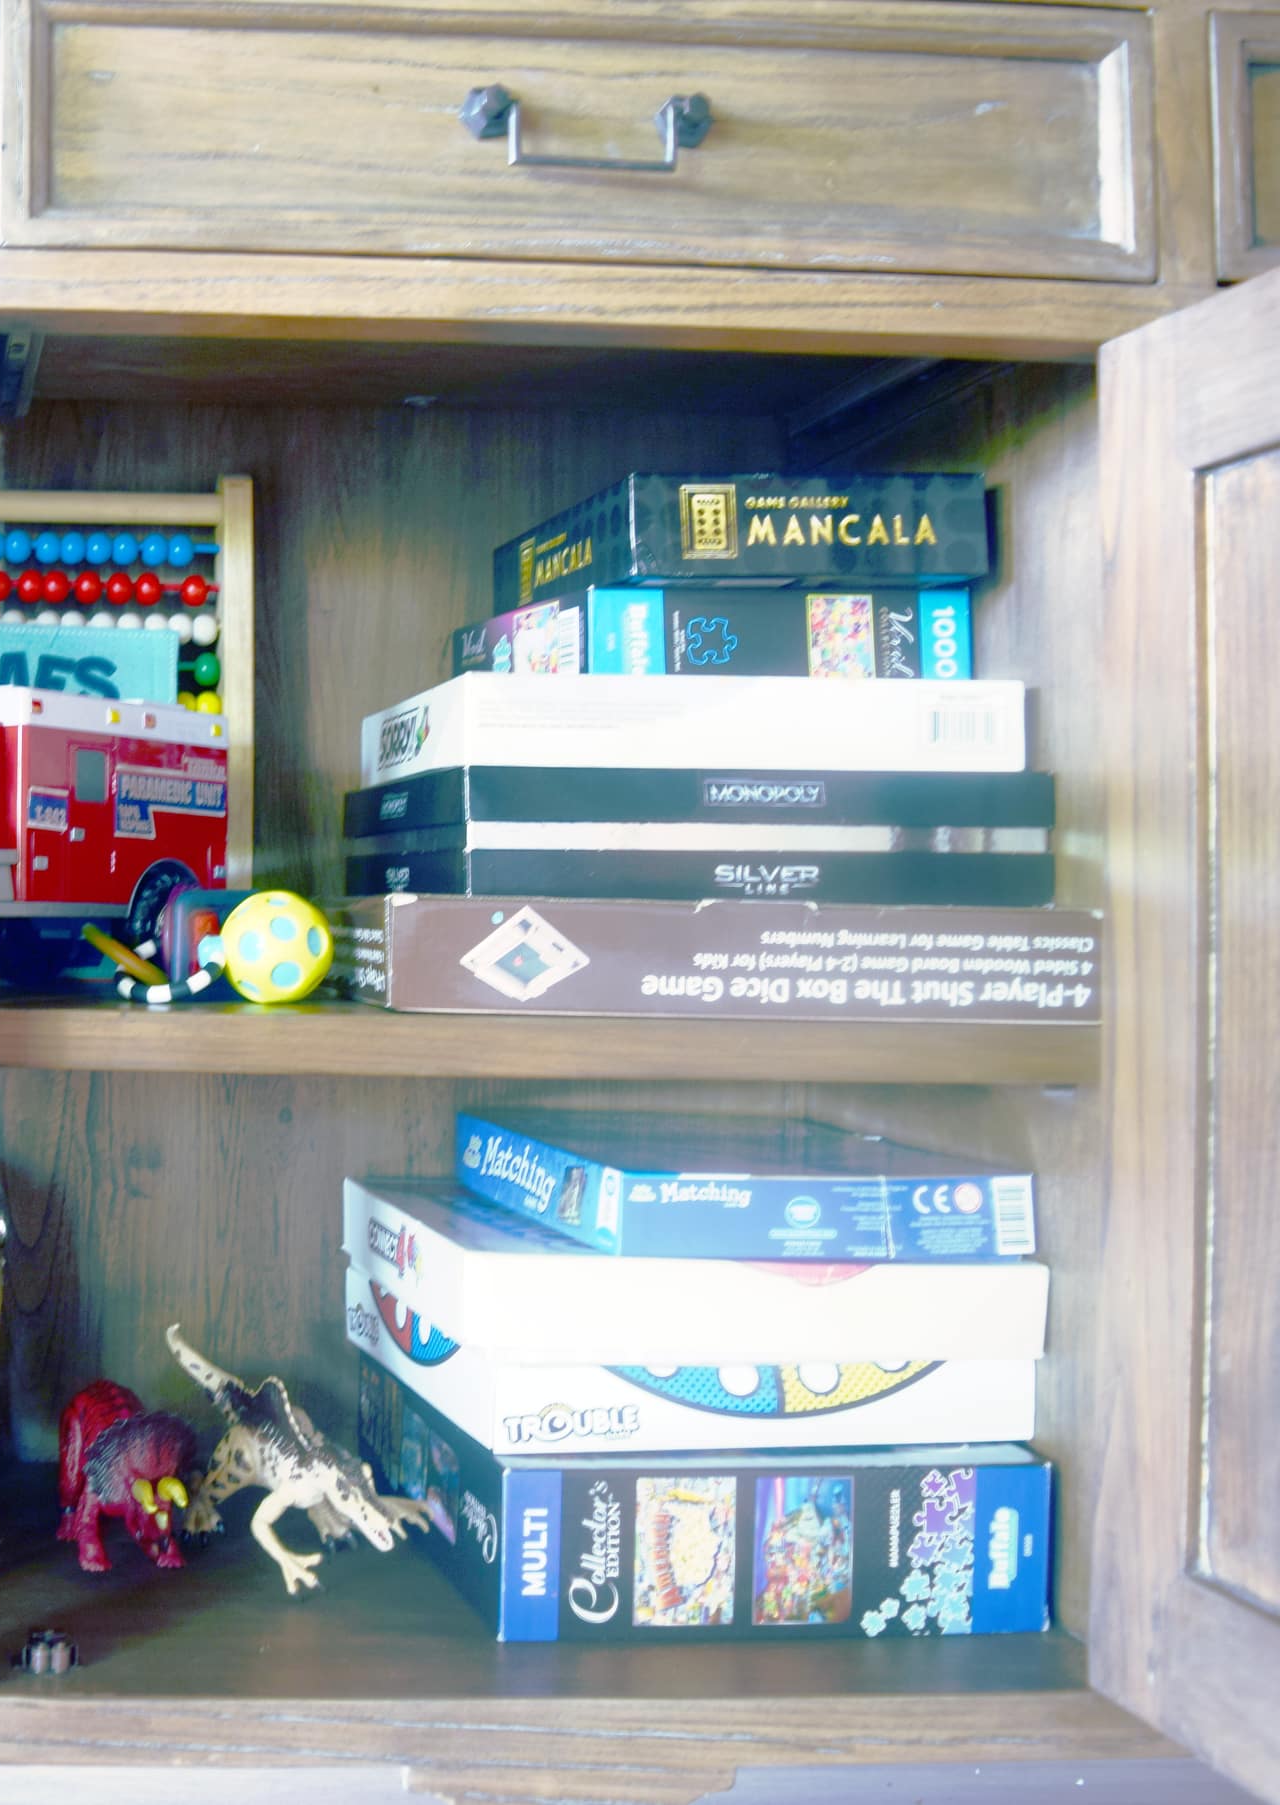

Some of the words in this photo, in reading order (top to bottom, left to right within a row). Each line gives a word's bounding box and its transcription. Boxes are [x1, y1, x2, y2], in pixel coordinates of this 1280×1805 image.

[744, 496, 786, 509] GAME
[788, 495, 849, 509] GALLERY
[747, 512, 937, 547] MANCALA
[533, 536, 593, 589] MANCALA
[932, 605, 958, 679] 1000
[709, 784, 820, 802] MONOPOLY
[714, 864, 819, 882] SILVER
[744, 883, 790, 895] LINE
[760, 931, 835, 948] Numbers
[837, 929, 907, 949] Learning
[909, 933, 934, 950] for
[936, 934, 985, 950] Game
[987, 935, 1030, 951] Table
[1031, 935, 1095, 952] Classics
[692, 952, 729, 970] Kids
[730, 952, 756, 970] for
[759, 952, 823, 972] Players)
[826, 953, 858, 973] (2-4
[860, 955, 909, 973] Game
[911, 956, 960, 974] Board
[963, 957, 1031, 975] Wooden
[1033, 959, 1079, 975] Sided
[641, 974, 724, 1002] Game
[730, 976, 790, 1004] Dice
[795, 977, 848, 1004] Box
[854, 979, 907, 1007] The
[911, 979, 975, 1007] Shut
[980, 976, 1092, 1008] 4-Player
[480, 1135, 557, 1214] Matching
[660, 1181, 752, 1208] Matching
[503, 1404, 641, 1444] TROUBLE
[605, 1501, 621, 1578] EDITION
[521, 1506, 549, 1596] MULTI
[569, 1479, 620, 1624] Collector's
